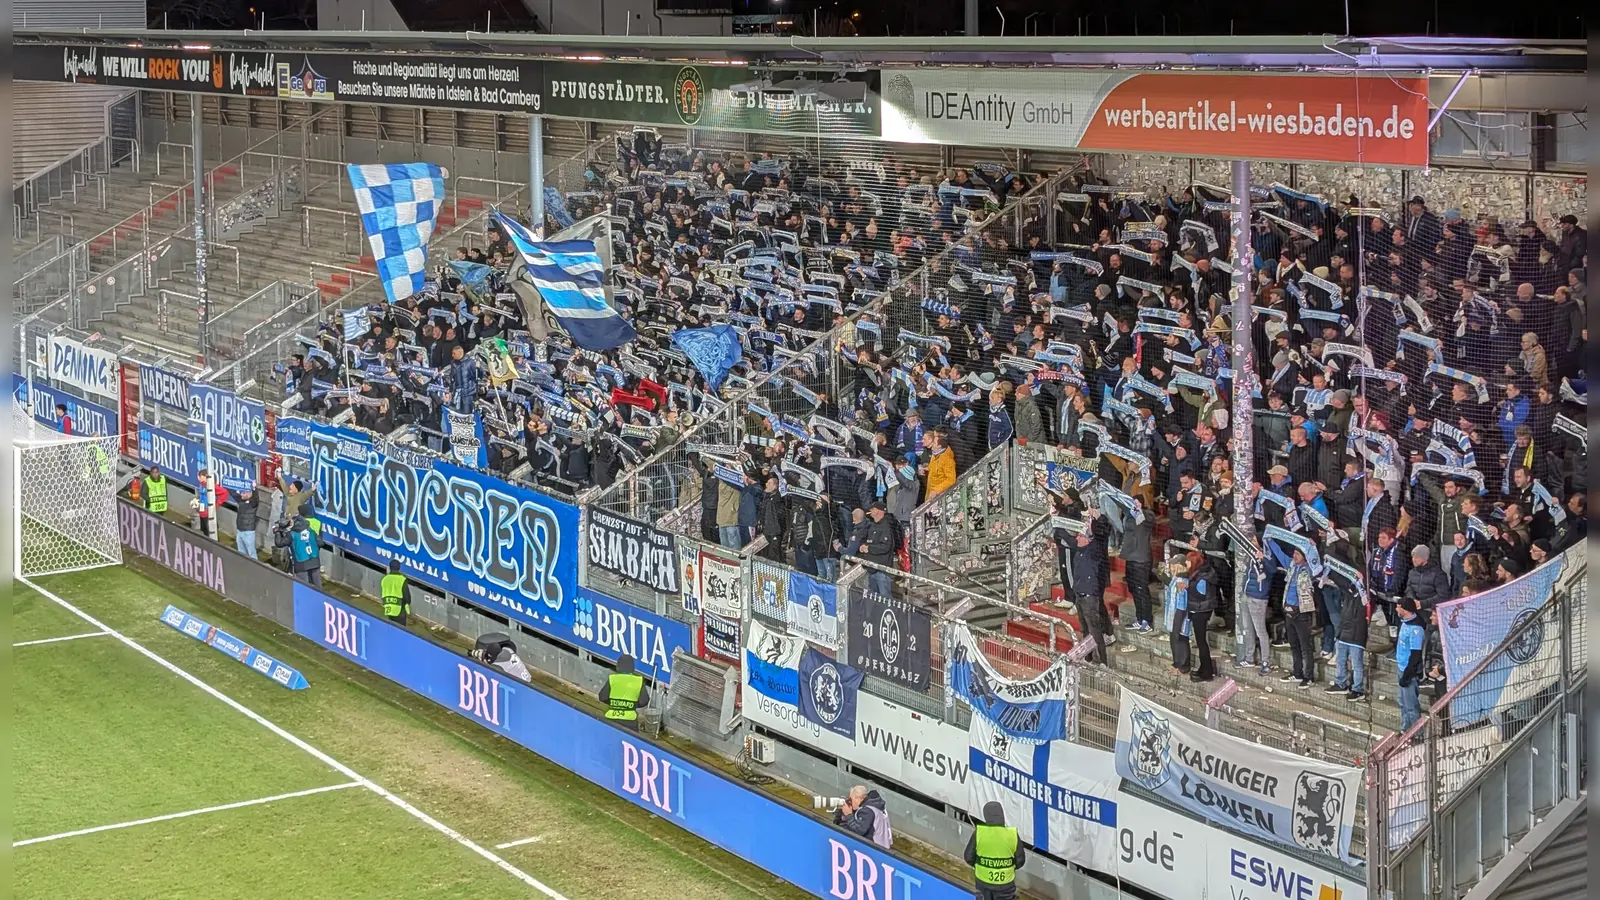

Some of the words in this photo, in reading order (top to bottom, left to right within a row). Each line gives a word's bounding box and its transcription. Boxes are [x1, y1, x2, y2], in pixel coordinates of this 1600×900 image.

[102, 56, 119, 77] WE
[120, 57, 148, 79] WILL
[149, 57, 180, 80] ROCK
[182, 59, 210, 82] YOU!
[352, 61, 379, 76] Frische
[379, 62, 393, 76] und
[393, 62, 438, 82] Regionalität
[438, 63, 456, 82] liegt
[457, 68, 472, 80] uns
[472, 68, 487, 81] am
[488, 65, 520, 82] Herzen!
[338, 80, 372, 96] Besuchen
[372, 82, 383, 96] Sie
[384, 84, 408, 98] unsere
[409, 82, 436, 99] Märkte
[437, 84, 445, 100] in
[446, 85, 473, 102] Idstein
[473, 87, 481, 101] &
[481, 87, 499, 103] Bad
[499, 89, 541, 111] Camberg
[551, 79, 669, 104] PFUNGSTÄDTER.
[924, 91, 1015, 129] IDEAntity
[1023, 100, 1073, 126] GmbH
[1104, 97, 1415, 140] werbeartikel-wiesbaden.de
[54, 342, 108, 390] DENNING
[33, 388, 59, 423] RITA
[77, 404, 109, 438] BRITA
[152, 433, 190, 477] BRITA
[118, 500, 171, 567] BRITA
[173, 537, 226, 595] ARENA
[589, 522, 679, 593] SIMBACH
[323, 601, 371, 661] BRIT
[595, 602, 671, 673] BRITA
[706, 616, 735, 636] WAMBO
[857, 655, 930, 684] OBERPFALZ
[458, 663, 516, 732] BRIT
[621, 739, 692, 821] BRIT
[984, 757, 1053, 807] GÖPPINGER
[1057, 789, 1101, 822] LÖWEN
[1177, 742, 1279, 799] KASINGER
[1180, 771, 1277, 836] LÖWEN
[979, 857, 1013, 868] STEWARD
[987, 871, 1006, 882] 326
[1230, 847, 1314, 900] ESWE
